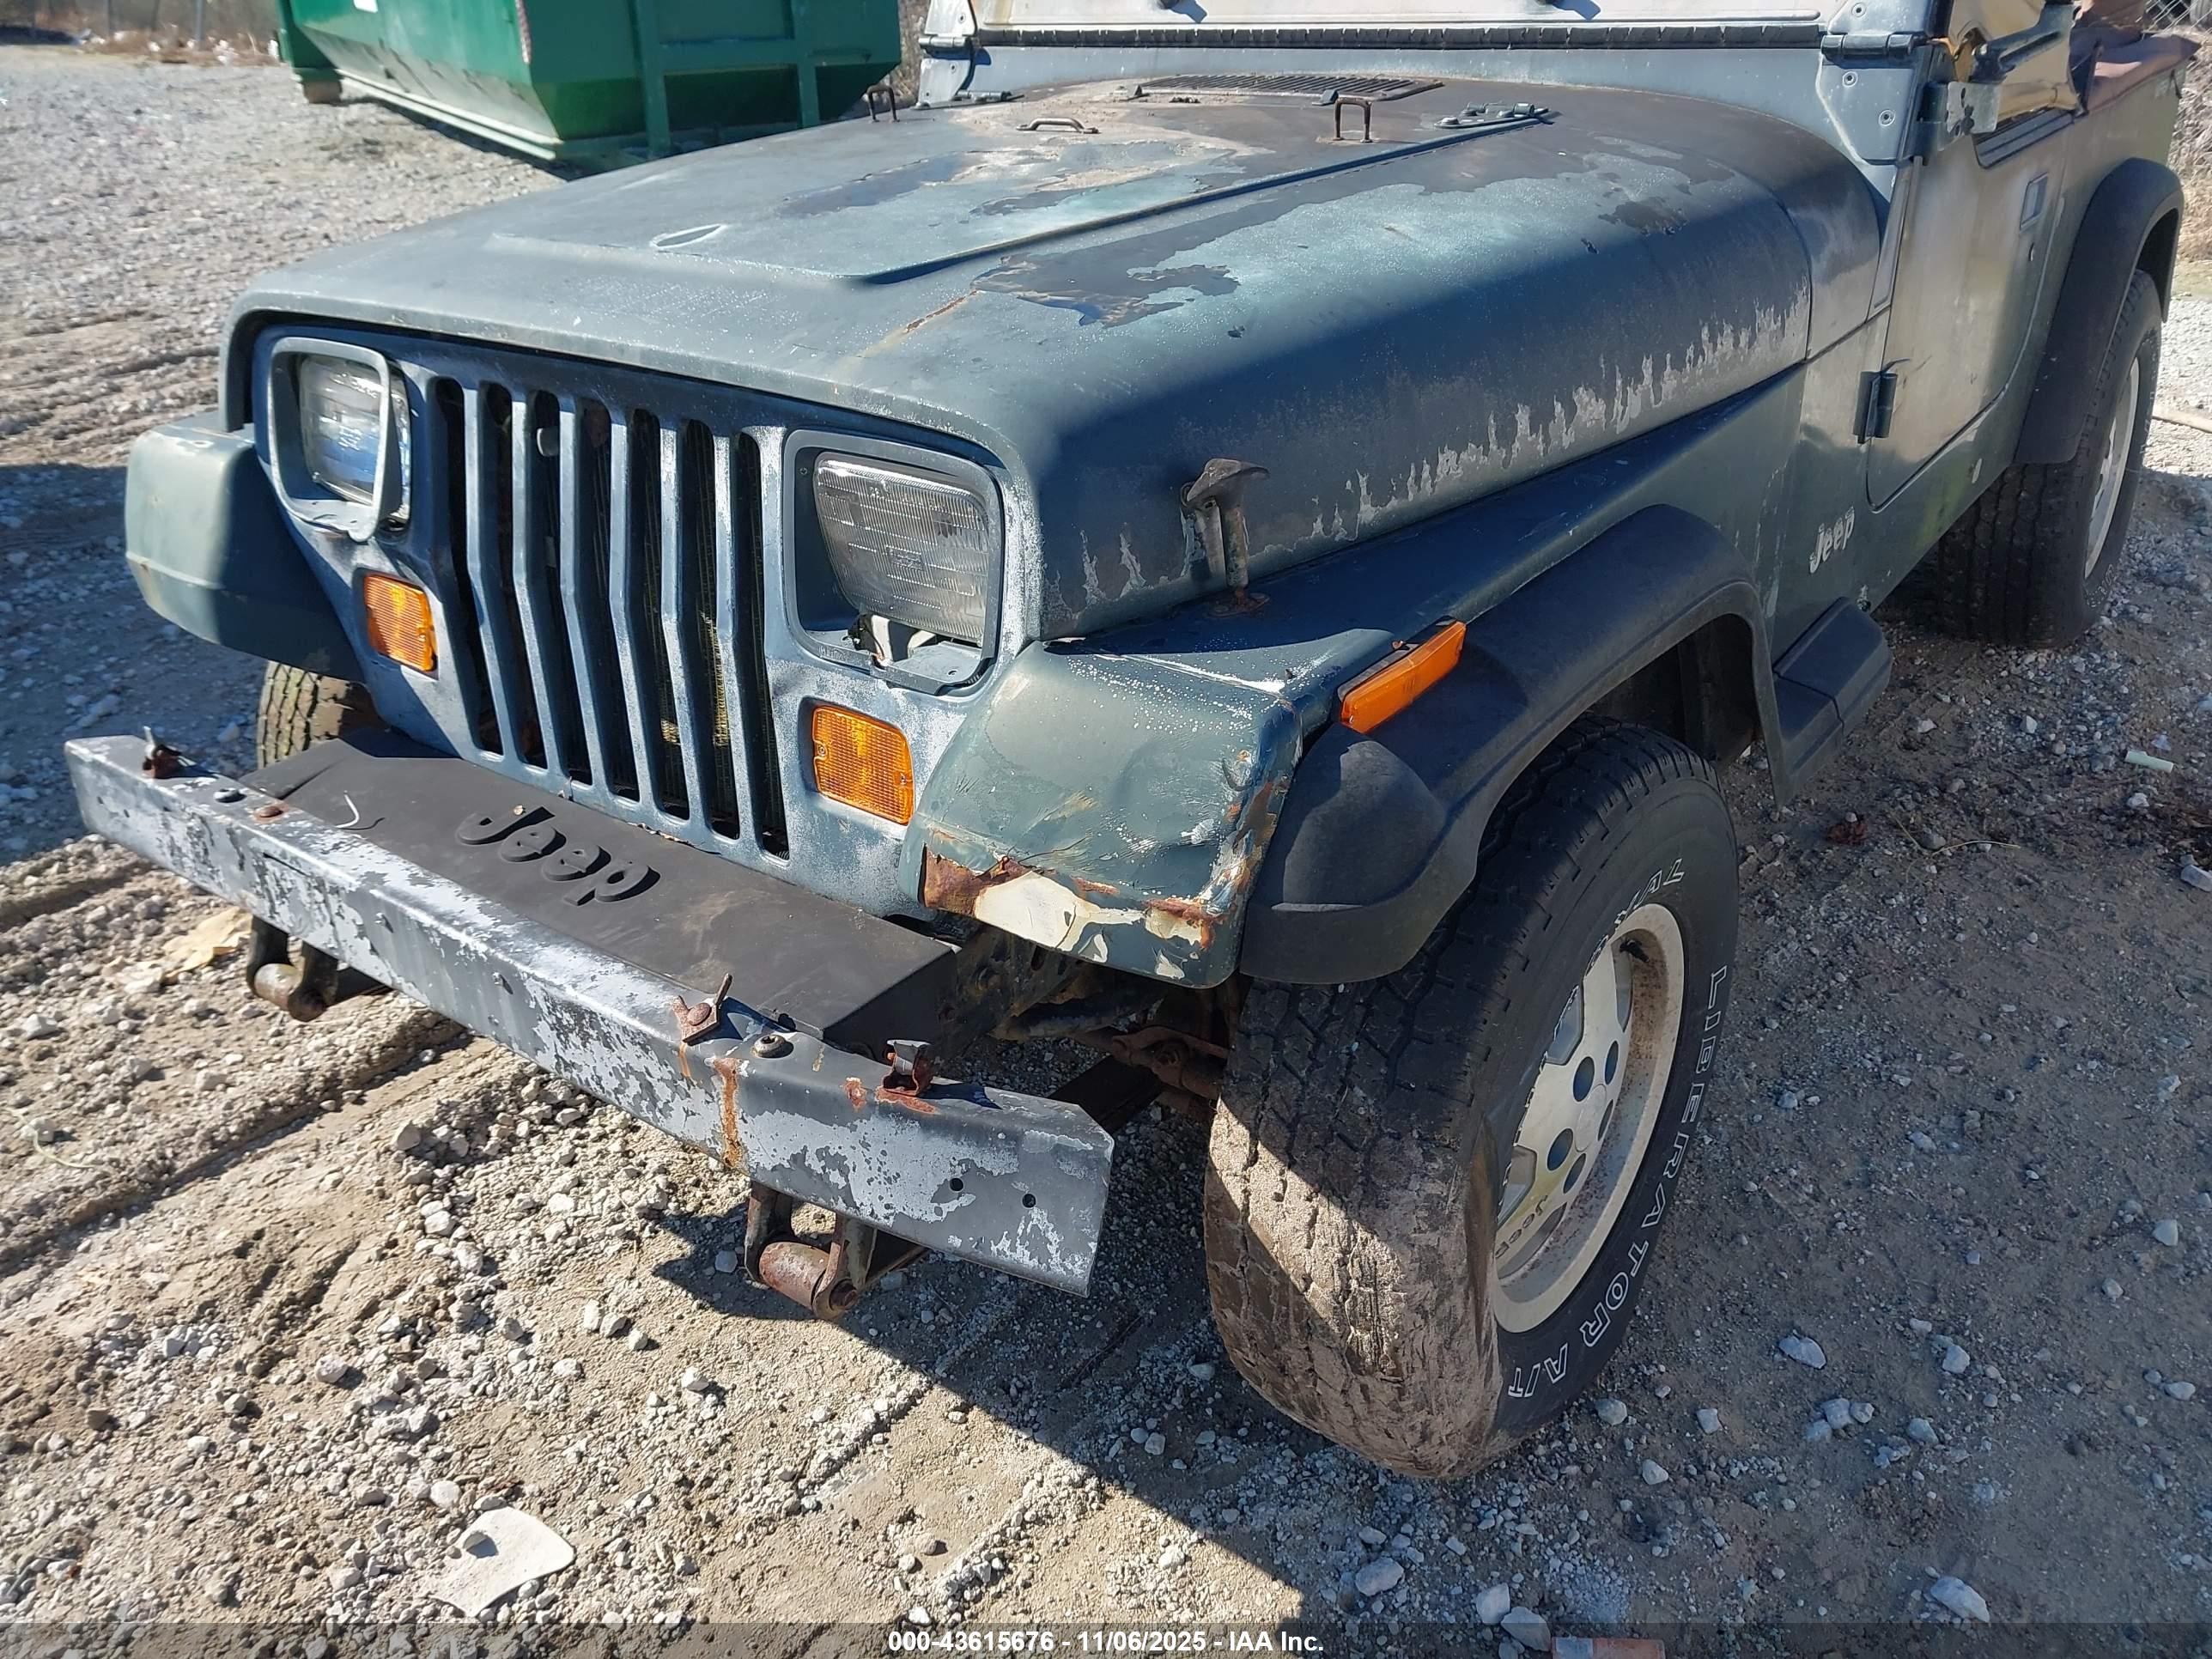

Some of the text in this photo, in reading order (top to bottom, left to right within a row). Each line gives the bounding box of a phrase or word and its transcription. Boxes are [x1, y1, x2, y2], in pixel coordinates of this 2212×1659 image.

[1808, 505, 1855, 574] Jeep
[456, 805, 661, 907] Jeep
[1579, 964, 1729, 1347] LIBERATOR
[1494, 1194, 1549, 1260] Jeep
[1507, 1341, 1569, 1398] A/T
